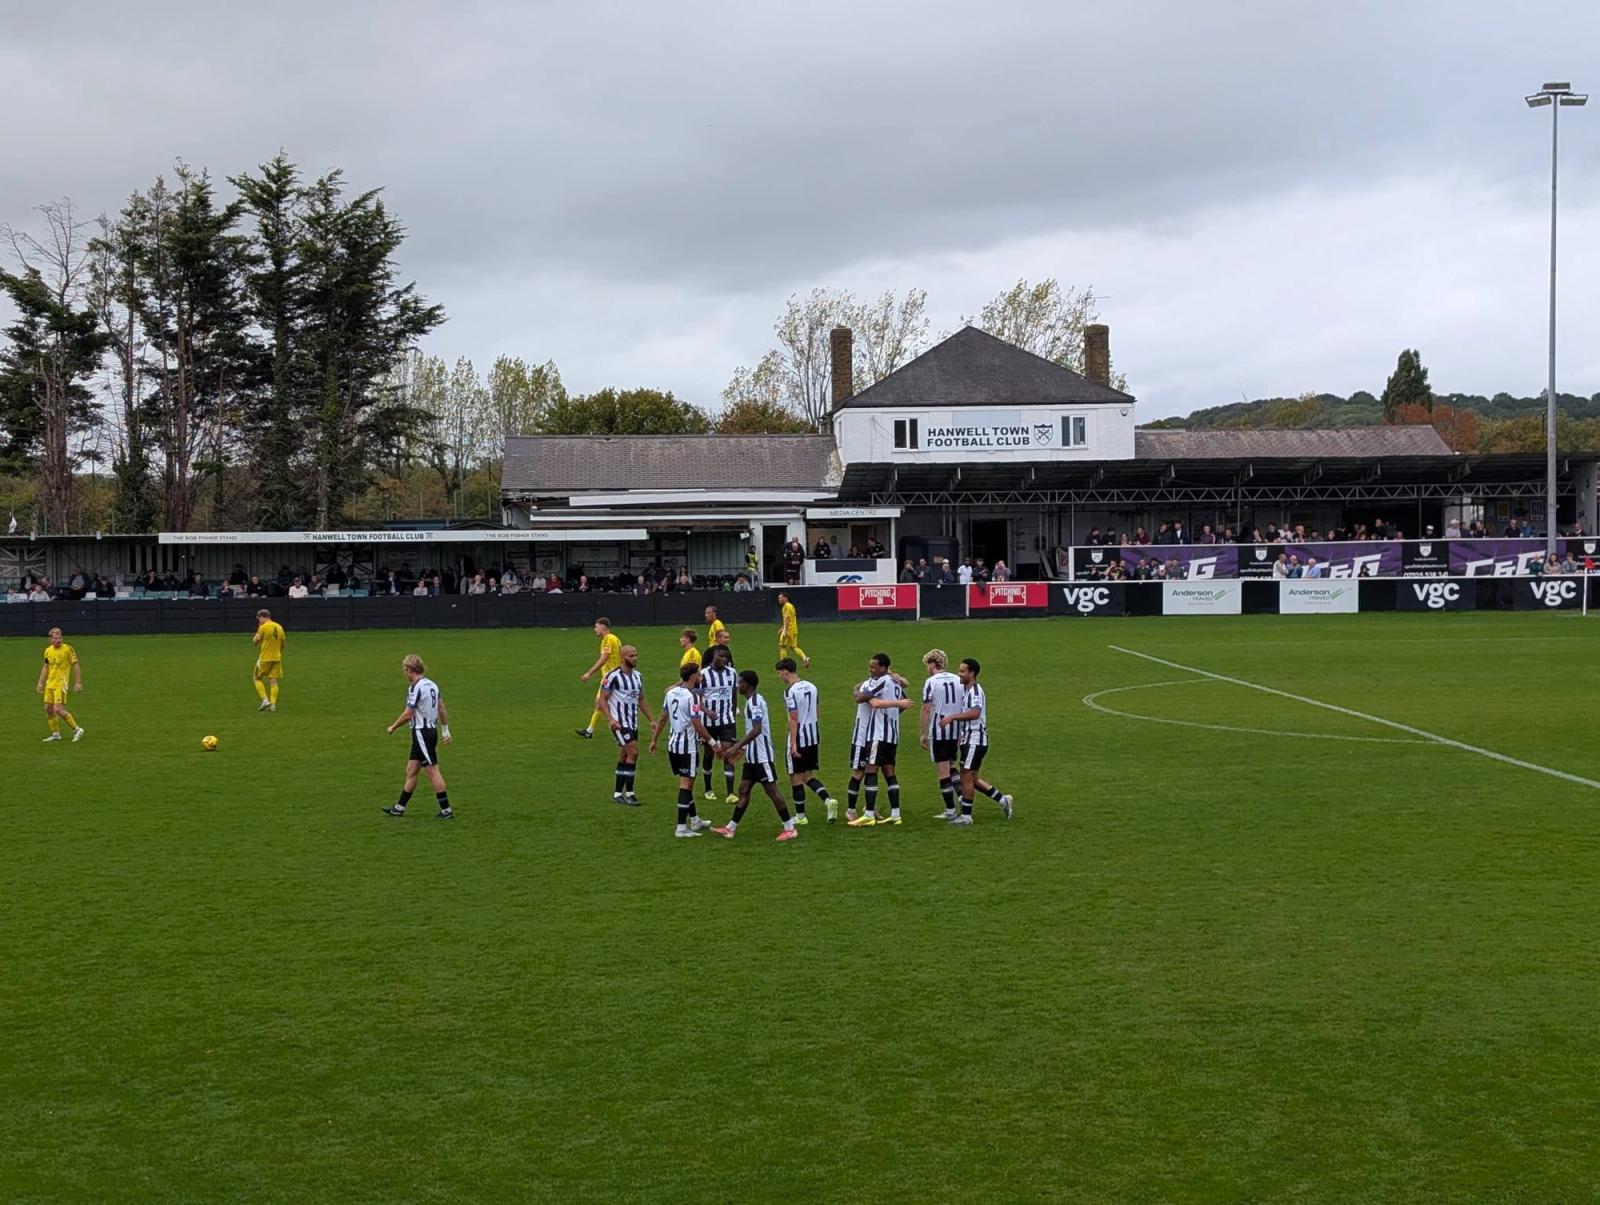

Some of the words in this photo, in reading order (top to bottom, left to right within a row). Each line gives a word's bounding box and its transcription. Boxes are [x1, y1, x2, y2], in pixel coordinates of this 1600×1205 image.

[928, 427, 989, 436] HANWELL
[992, 427, 1029, 435] TOWN
[927, 437, 993, 447] FOOTBALL
[996, 437, 1030, 446] CLUB
[864, 589, 891, 598] PITCHING
[994, 587, 1021, 596] PITCHING
[1063, 587, 1110, 612] vgc
[1412, 582, 1460, 609] vgc
[1530, 580, 1577, 606] vgc
[273, 627, 278, 640] 4
[430, 688, 436, 708] 8
[804, 691, 811, 712] 7
[944, 682, 956, 704] 11
[671, 698, 679, 720] 2
